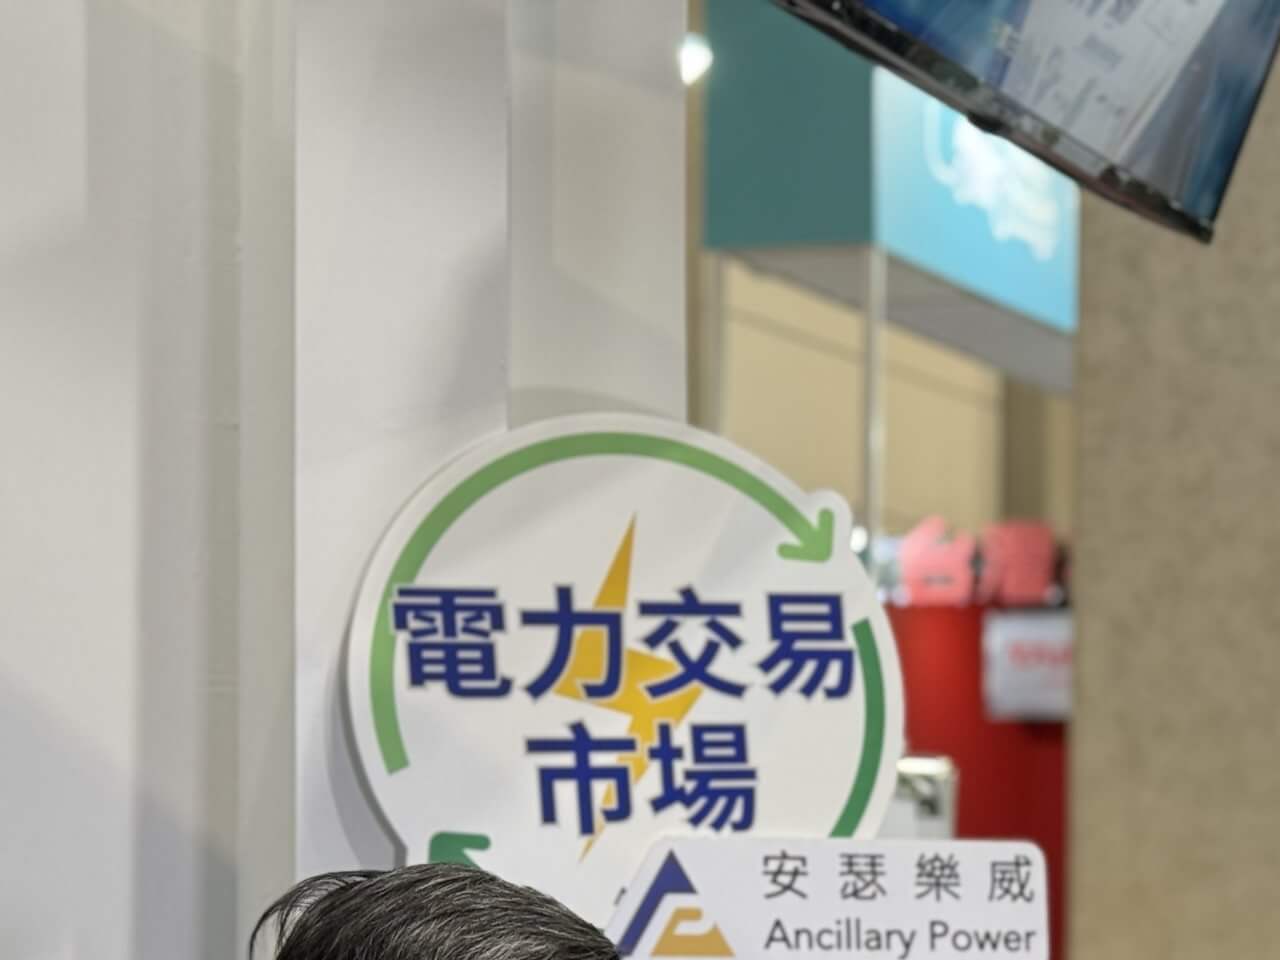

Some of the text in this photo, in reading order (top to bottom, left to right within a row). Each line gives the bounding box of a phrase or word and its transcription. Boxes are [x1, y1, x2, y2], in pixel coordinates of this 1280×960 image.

[393, 585, 856, 701] 電力交易
[524, 720, 758, 837] 市場
[762, 849, 1036, 903] 安瑟樂威
[764, 917, 1036, 960] Ancillary Power
